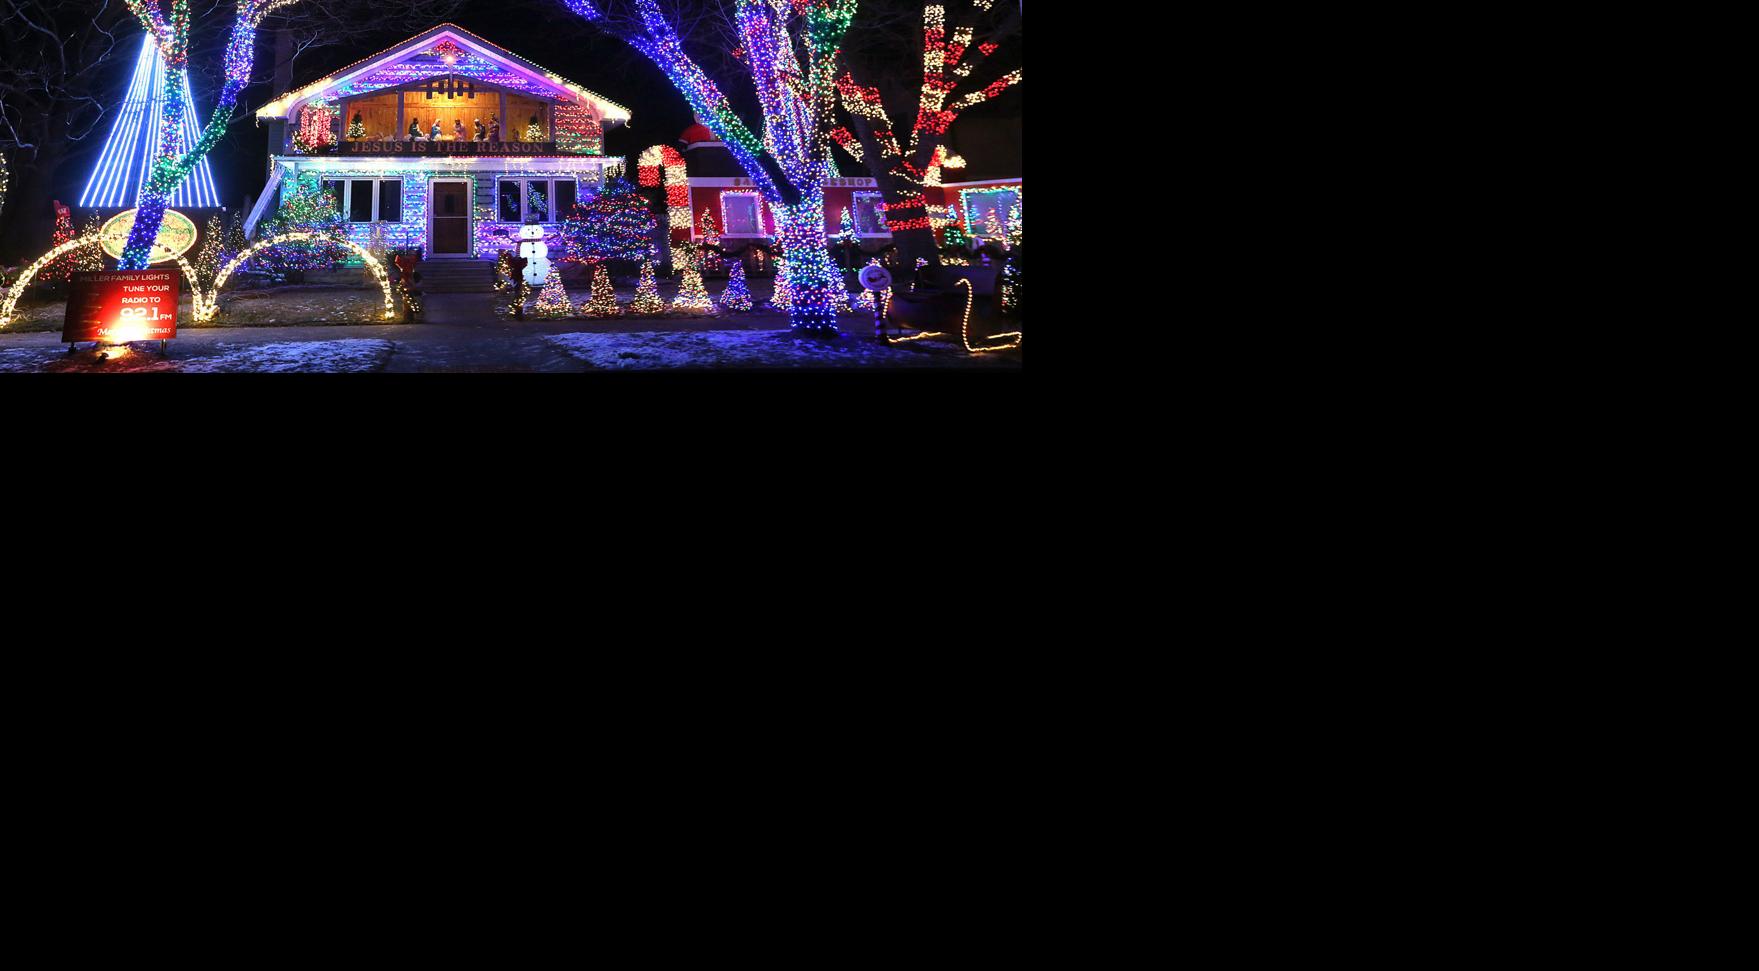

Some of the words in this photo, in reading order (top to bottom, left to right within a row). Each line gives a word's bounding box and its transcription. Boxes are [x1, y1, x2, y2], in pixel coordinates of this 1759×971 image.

[351, 142, 403, 152] JESUS
[412, 142, 426, 152] IS
[435, 142, 469, 152] THE
[477, 142, 544, 152] REASON
[141, 273, 170, 281] LIGHTS
